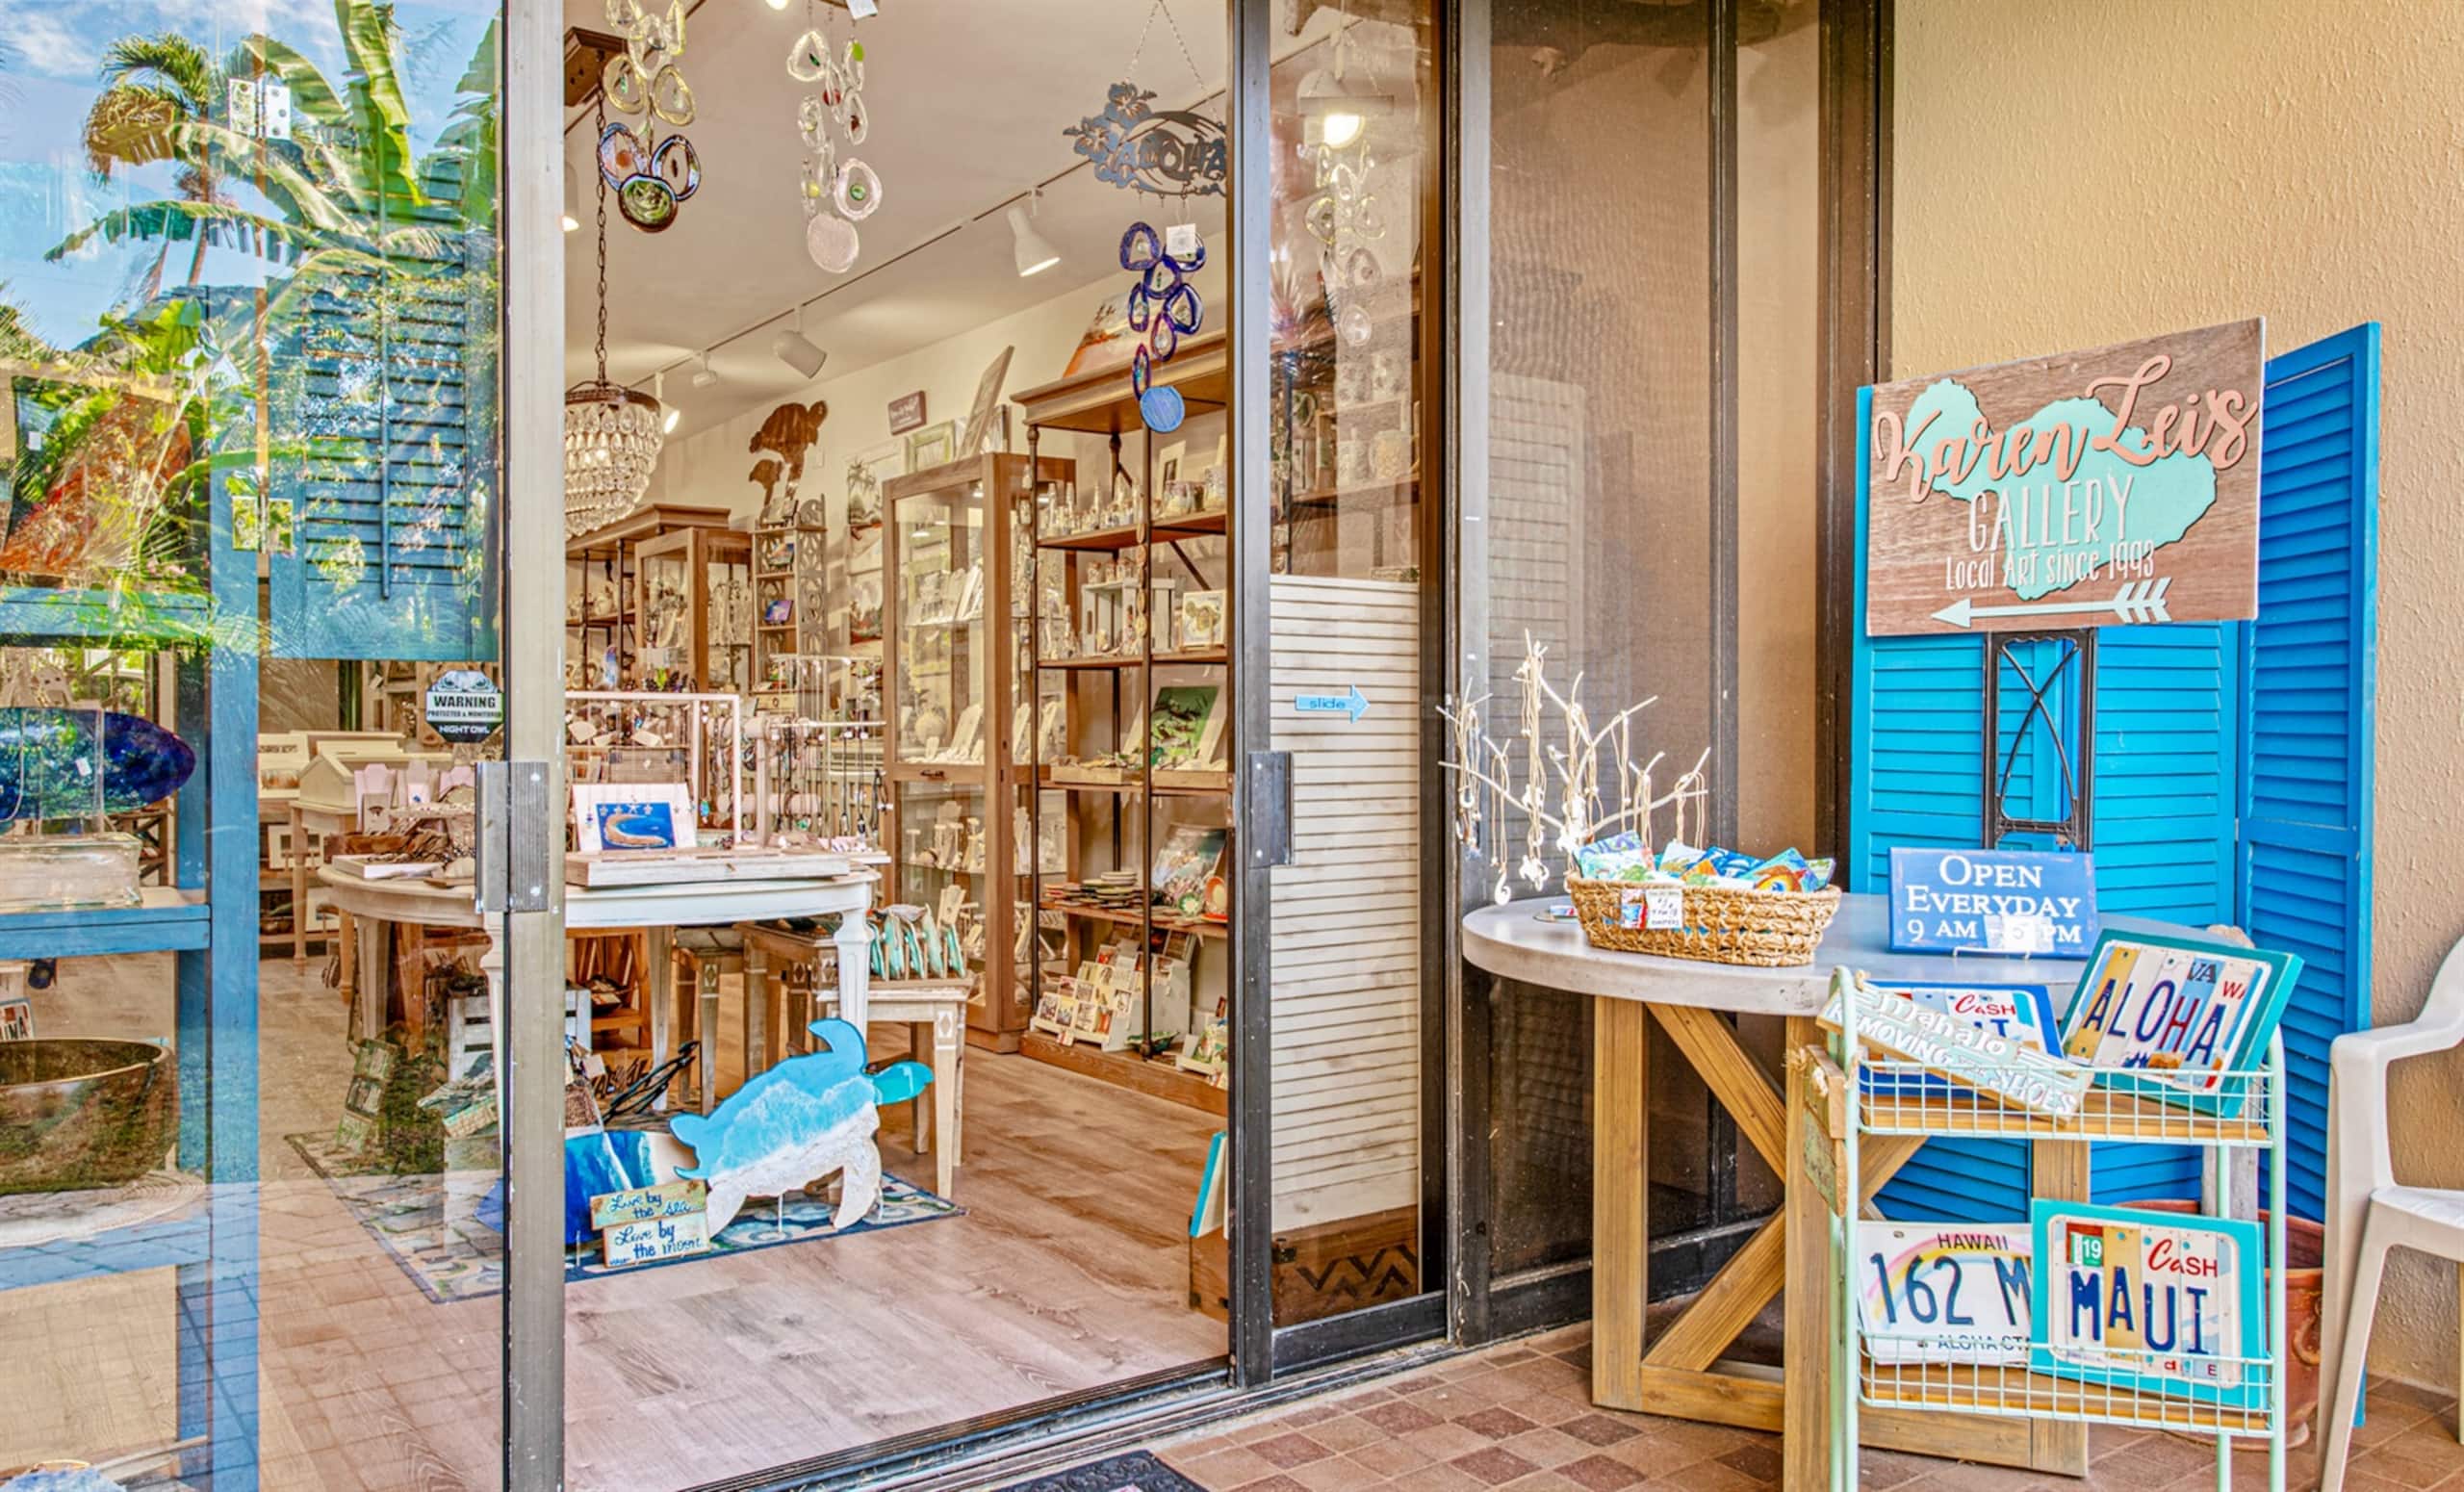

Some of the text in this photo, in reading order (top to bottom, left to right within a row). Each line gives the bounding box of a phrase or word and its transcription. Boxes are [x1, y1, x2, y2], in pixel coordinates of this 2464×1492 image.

[1875, 354, 2258, 503] Karen Leis
[1968, 474, 2134, 553] GALLERY
[1945, 553, 1995, 591] Local
[2109, 539, 2155, 579] 1993
[433, 695, 496, 708] WARNING
[1309, 697, 1346, 708] slide
[1939, 855, 2043, 888] OPEN
[1906, 885, 2082, 918] EVERYDAY
[1907, 918, 1924, 942] 9
[1936, 920, 1978, 939] AM
[2042, 923, 2083, 943] PM
[1830, 1002, 1952, 1065] RMOVING
[2082, 978, 2227, 1066] ALOHA
[632, 1207, 654, 1219] the
[645, 1191, 662, 1208] by
[657, 1220, 675, 1243] by
[1937, 1233, 2009, 1250] HAWAII
[632, 1243, 656, 1258] the
[2082, 1236, 2102, 1259] 19
[1869, 1252, 1974, 1326] 162
[2070, 1266, 2210, 1355] MAUI
